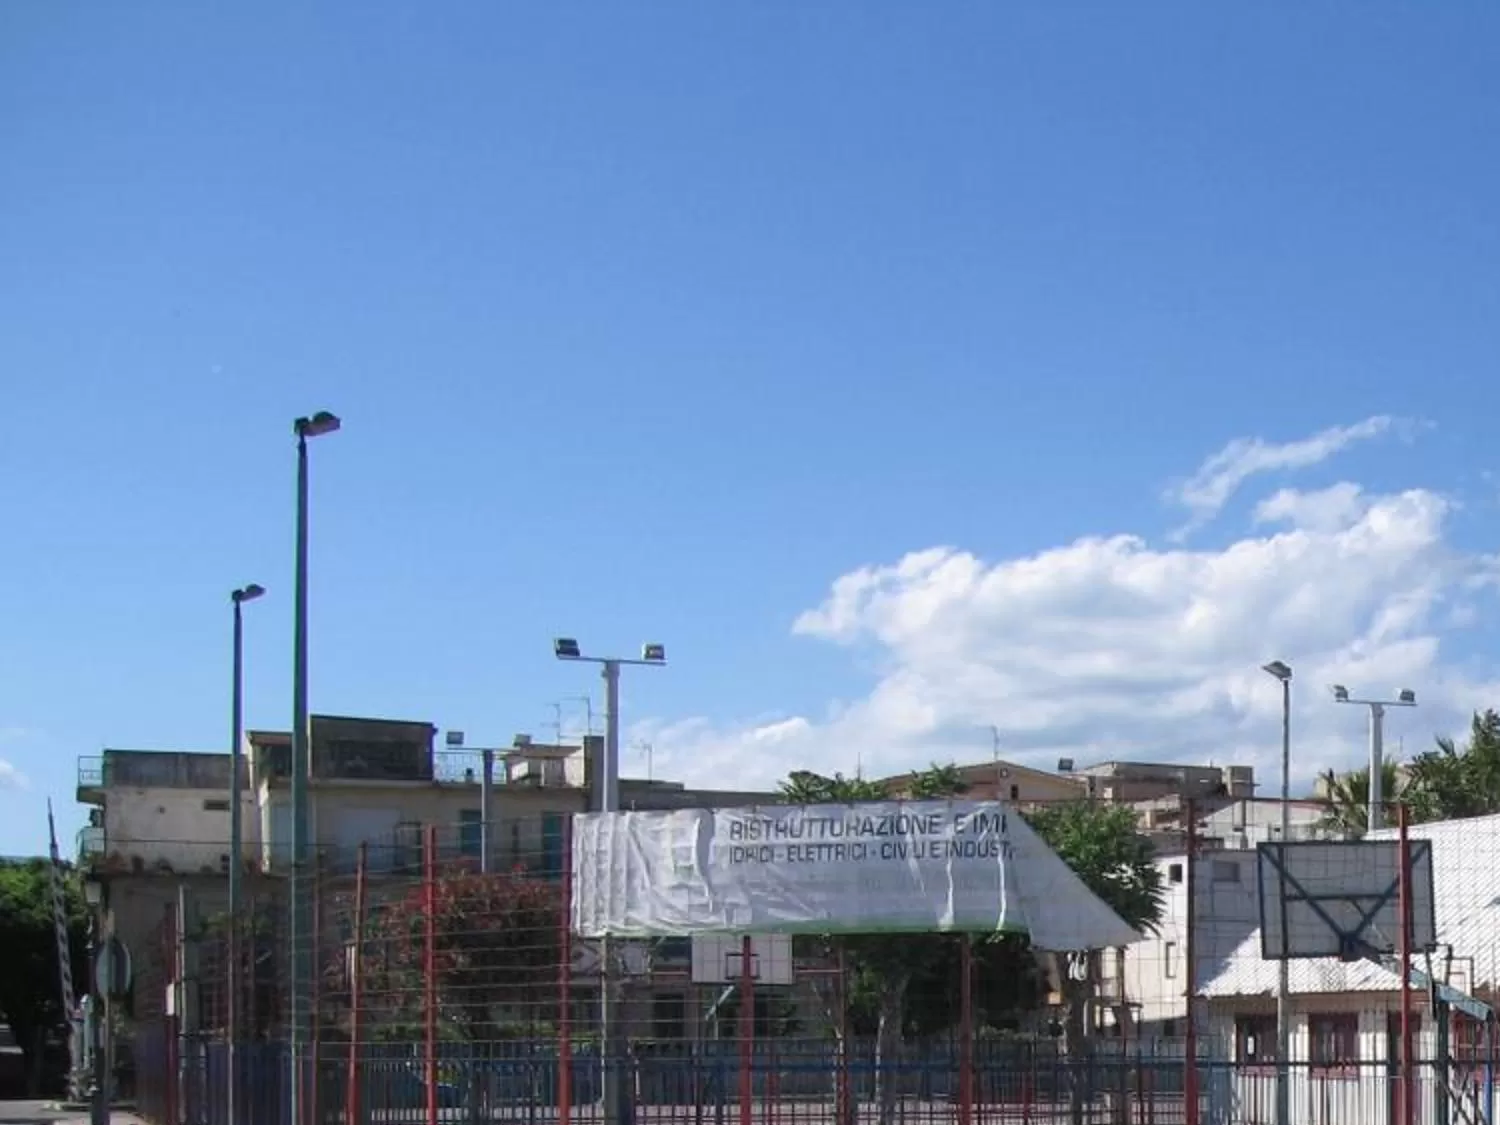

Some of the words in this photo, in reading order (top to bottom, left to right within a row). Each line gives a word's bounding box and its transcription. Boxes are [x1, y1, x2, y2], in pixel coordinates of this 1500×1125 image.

[730, 814, 943, 840] RISTRUTTURAZIONE
[787, 843, 867, 862] ELETTRICI
[929, 840, 942, 858] E
